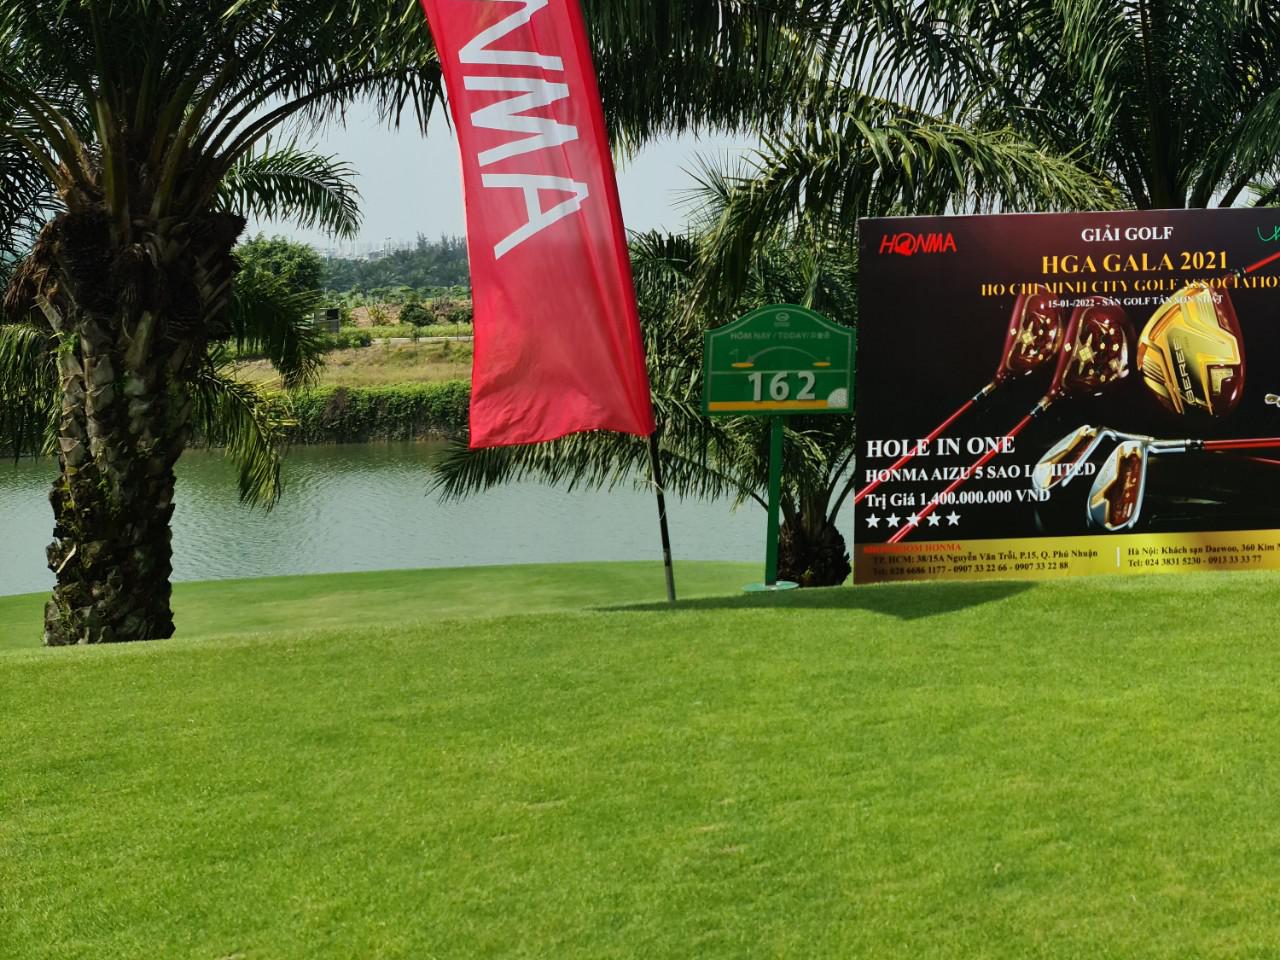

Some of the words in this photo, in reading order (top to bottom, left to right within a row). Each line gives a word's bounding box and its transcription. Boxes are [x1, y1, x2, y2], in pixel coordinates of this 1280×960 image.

[1081, 224, 1120, 242] GIẢI
[1124, 226, 1174, 241] GOLF
[879, 231, 957, 256] HONMA
[1041, 254, 1098, 275] HGA
[1102, 251, 1175, 273] GALA
[1179, 250, 1227, 270] 2021
[981, 283, 1006, 297] HO
[1009, 282, 1039, 295] CHI
[1043, 280, 1088, 294] MINH
[1091, 279, 1127, 293] CITY
[1133, 277, 1178, 291] GOLF
[1102, 295, 1122, 307] SÂN
[1123, 295, 1152, 306] GOLF
[748, 370, 816, 401] 162
[866, 438, 929, 458] HOLE
[936, 437, 961, 456] IN
[966, 436, 1015, 455] ONE
[865, 467, 929, 483] HONMA
[931, 467, 971, 481] AIZU
[974, 466, 984, 480] 5
[986, 464, 1021, 479] SAO
[865, 493, 886, 510] Trị
[890, 492, 915, 507] Giá
[919, 490, 1012, 507] 1.400.000.000
